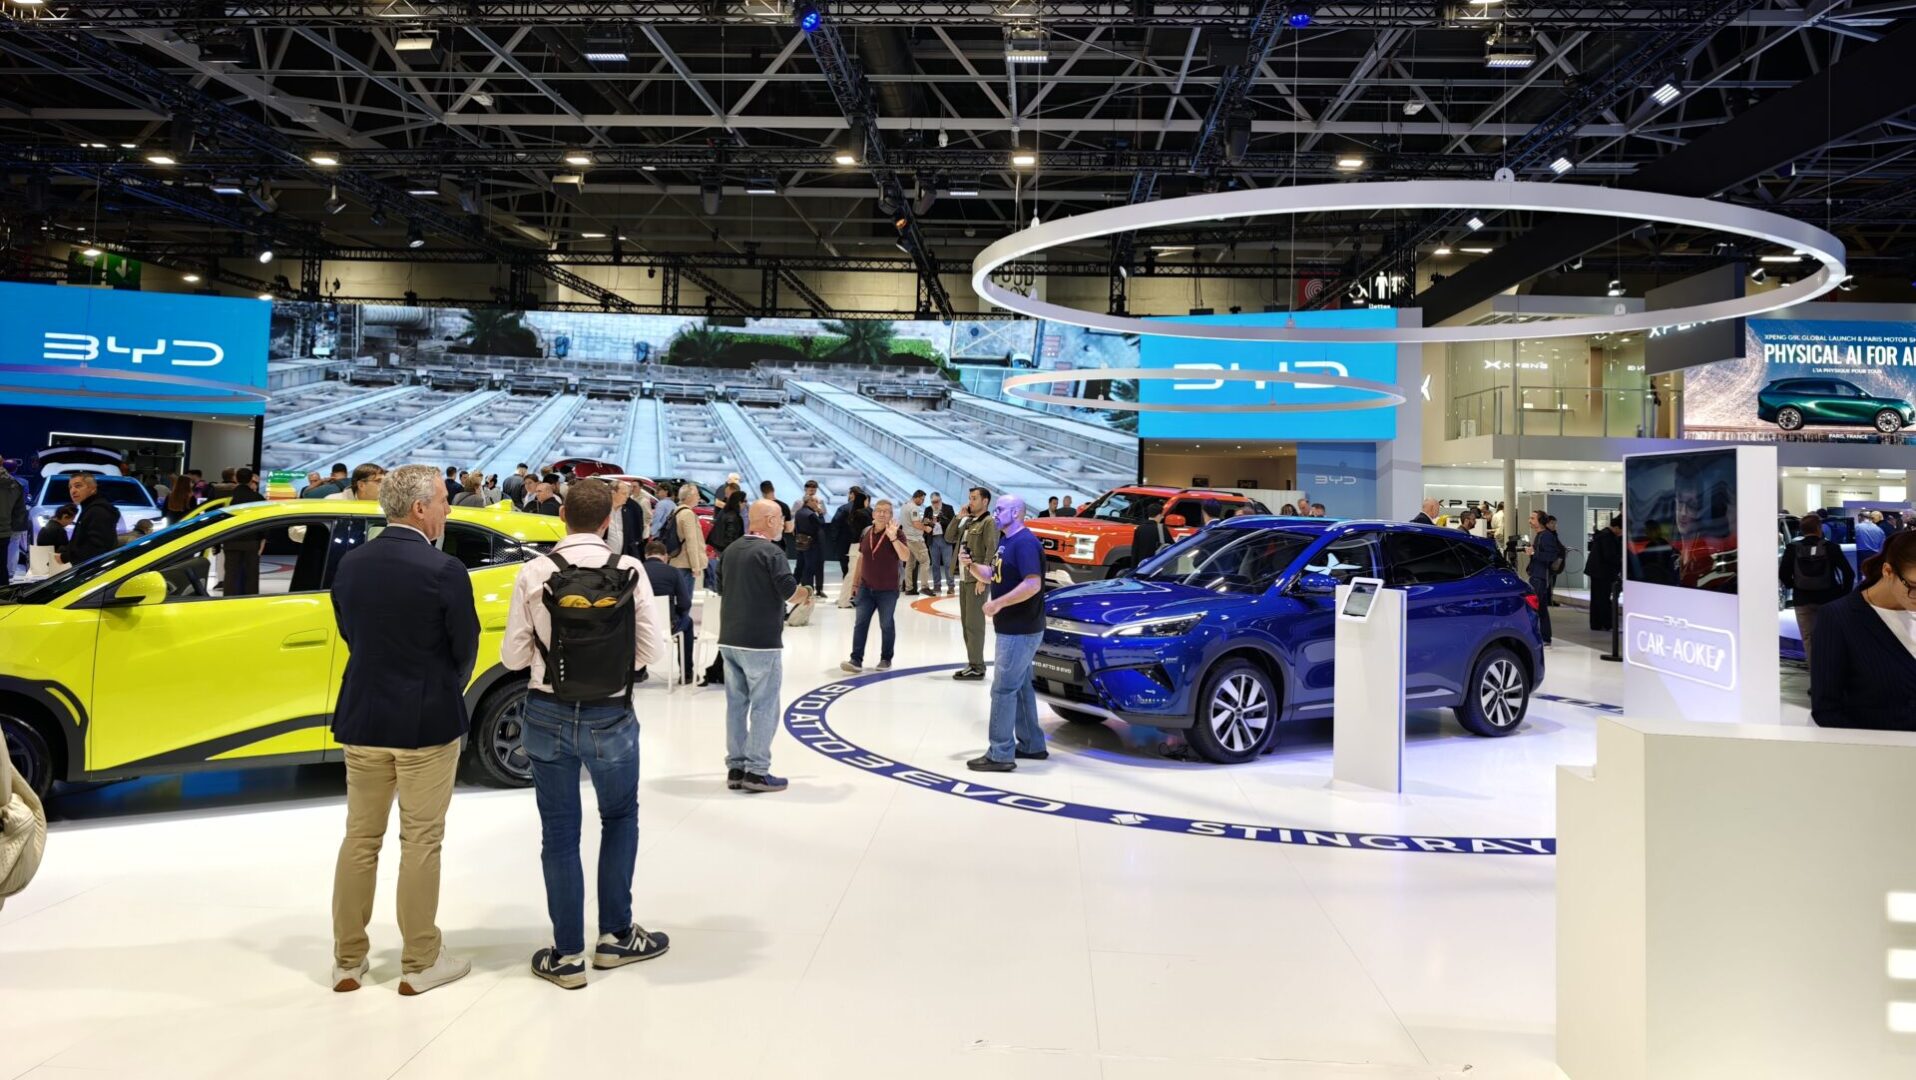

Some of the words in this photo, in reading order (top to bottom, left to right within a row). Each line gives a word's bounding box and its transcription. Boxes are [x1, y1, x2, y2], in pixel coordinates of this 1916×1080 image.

[43, 332, 225, 367] BYD
[1764, 344, 1842, 365] PHYSICAL
[1845, 346, 1862, 366] AI
[1866, 346, 1898, 366] FOR
[1315, 475, 1357, 485] BYD
[794, 684, 855, 711] BYD
[790, 712, 856, 753] ATTO
[843, 754, 895, 769] 3
[892, 770, 1066, 812] EVO
[1187, 821, 1552, 854] STINGRAY
